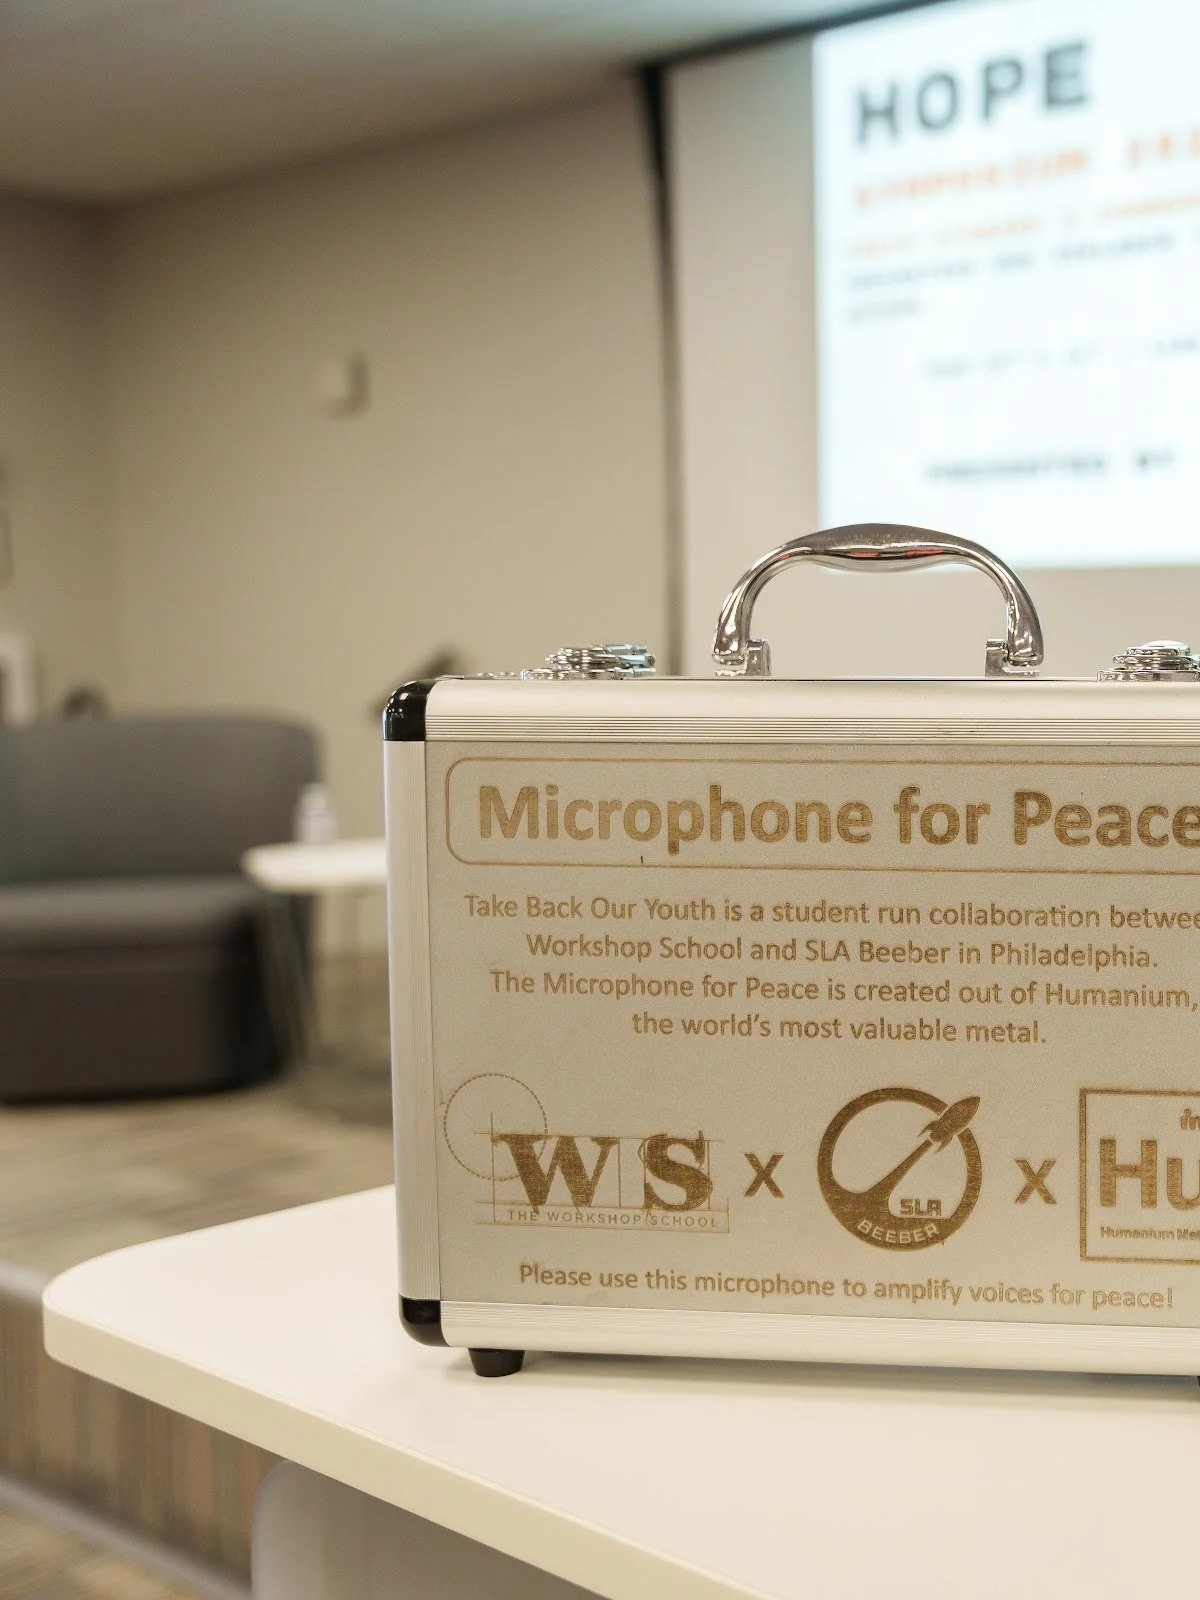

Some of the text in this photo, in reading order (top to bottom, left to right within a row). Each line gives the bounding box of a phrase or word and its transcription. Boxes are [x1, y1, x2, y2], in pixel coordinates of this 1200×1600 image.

[857, 41, 1088, 147] HOPE
[480, 785, 872, 855] Microphone
[894, 786, 989, 844] for
[466, 896, 516, 916] Take
[528, 897, 581, 917] Back
[592, 898, 635, 918] Our
[646, 900, 714, 919] Youth
[726, 900, 741, 921] is
[751, 905, 763, 921] a
[774, 901, 868, 922] student
[879, 908, 919, 923] run
[930, 904, 1098, 926] collaboration
[528, 935, 1156, 971] Workshop School and SLA Beeber in Philadelphia.
[491, 971, 1197, 1010] The Microphone for Peace is created out of Humanium,
[633, 1013, 672, 1033] the
[781, 1020, 840, 1037] most
[851, 1018, 955, 1040] valuable
[967, 1022, 1044, 1042] metal.
[507, 1210, 718, 1228] THE WORKSHOP SCHOOL
[900, 1199, 942, 1216] SLA
[857, 1219, 940, 1244] BEEBER
[1100, 1226, 1175, 1240] Humanium
[520, 1264, 1171, 1309] Please use this microphone to amplify voices for peace!
